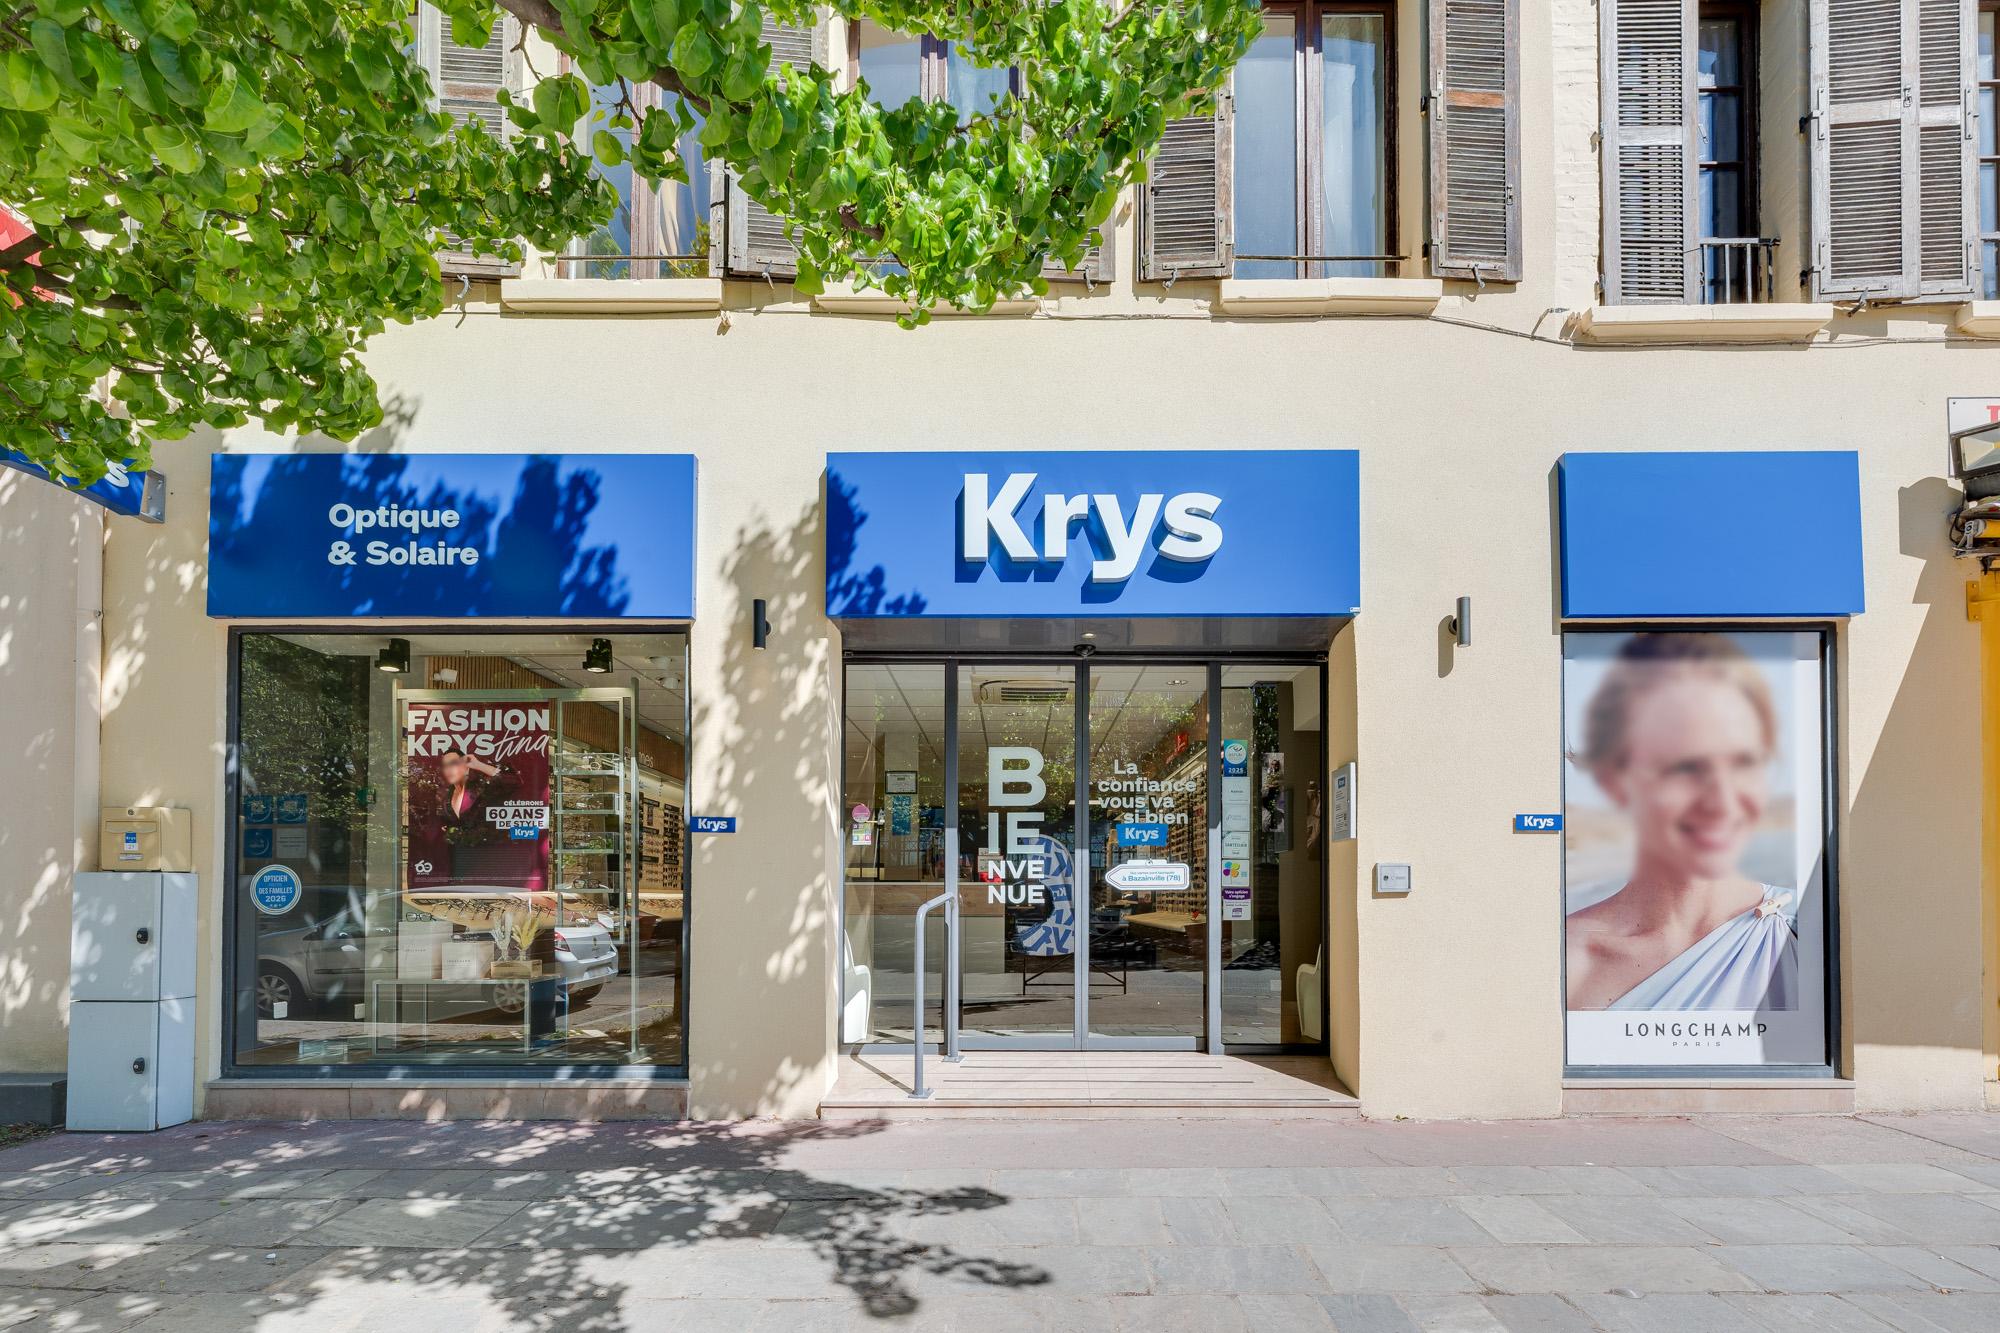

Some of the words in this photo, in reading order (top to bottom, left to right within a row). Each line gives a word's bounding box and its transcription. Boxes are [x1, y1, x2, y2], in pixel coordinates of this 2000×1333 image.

[329, 503, 460, 534] Optique
[964, 472, 1223, 583] Krys
[327, 540, 357, 565] &
[366, 540, 479, 566] Solaire
[408, 709, 549, 732] FASHION
[1114, 759, 1138, 775] La
[1098, 777, 1196, 792] confiance
[504, 799, 544, 807] CÉLÉBRONS
[1098, 796, 1146, 809] vous
[1150, 796, 1175, 809] va
[488, 808, 508, 820] 60
[511, 808, 544, 820] ANS
[1123, 810, 1140, 824] si
[1145, 809, 1188, 824] bien
[697, 818, 728, 832] Krys
[1524, 815, 1555, 829] Krys
[514, 828, 535, 838] Krys
[1125, 827, 1160, 842] Krys
[263, 875, 288, 883] OPTICIEN
[1166, 874, 1181, 882] (78)
[258, 887, 269, 895] DES
[269, 886, 293, 895] FAMILLES
[1625, 1023, 1767, 1037] LONGCHAMP
